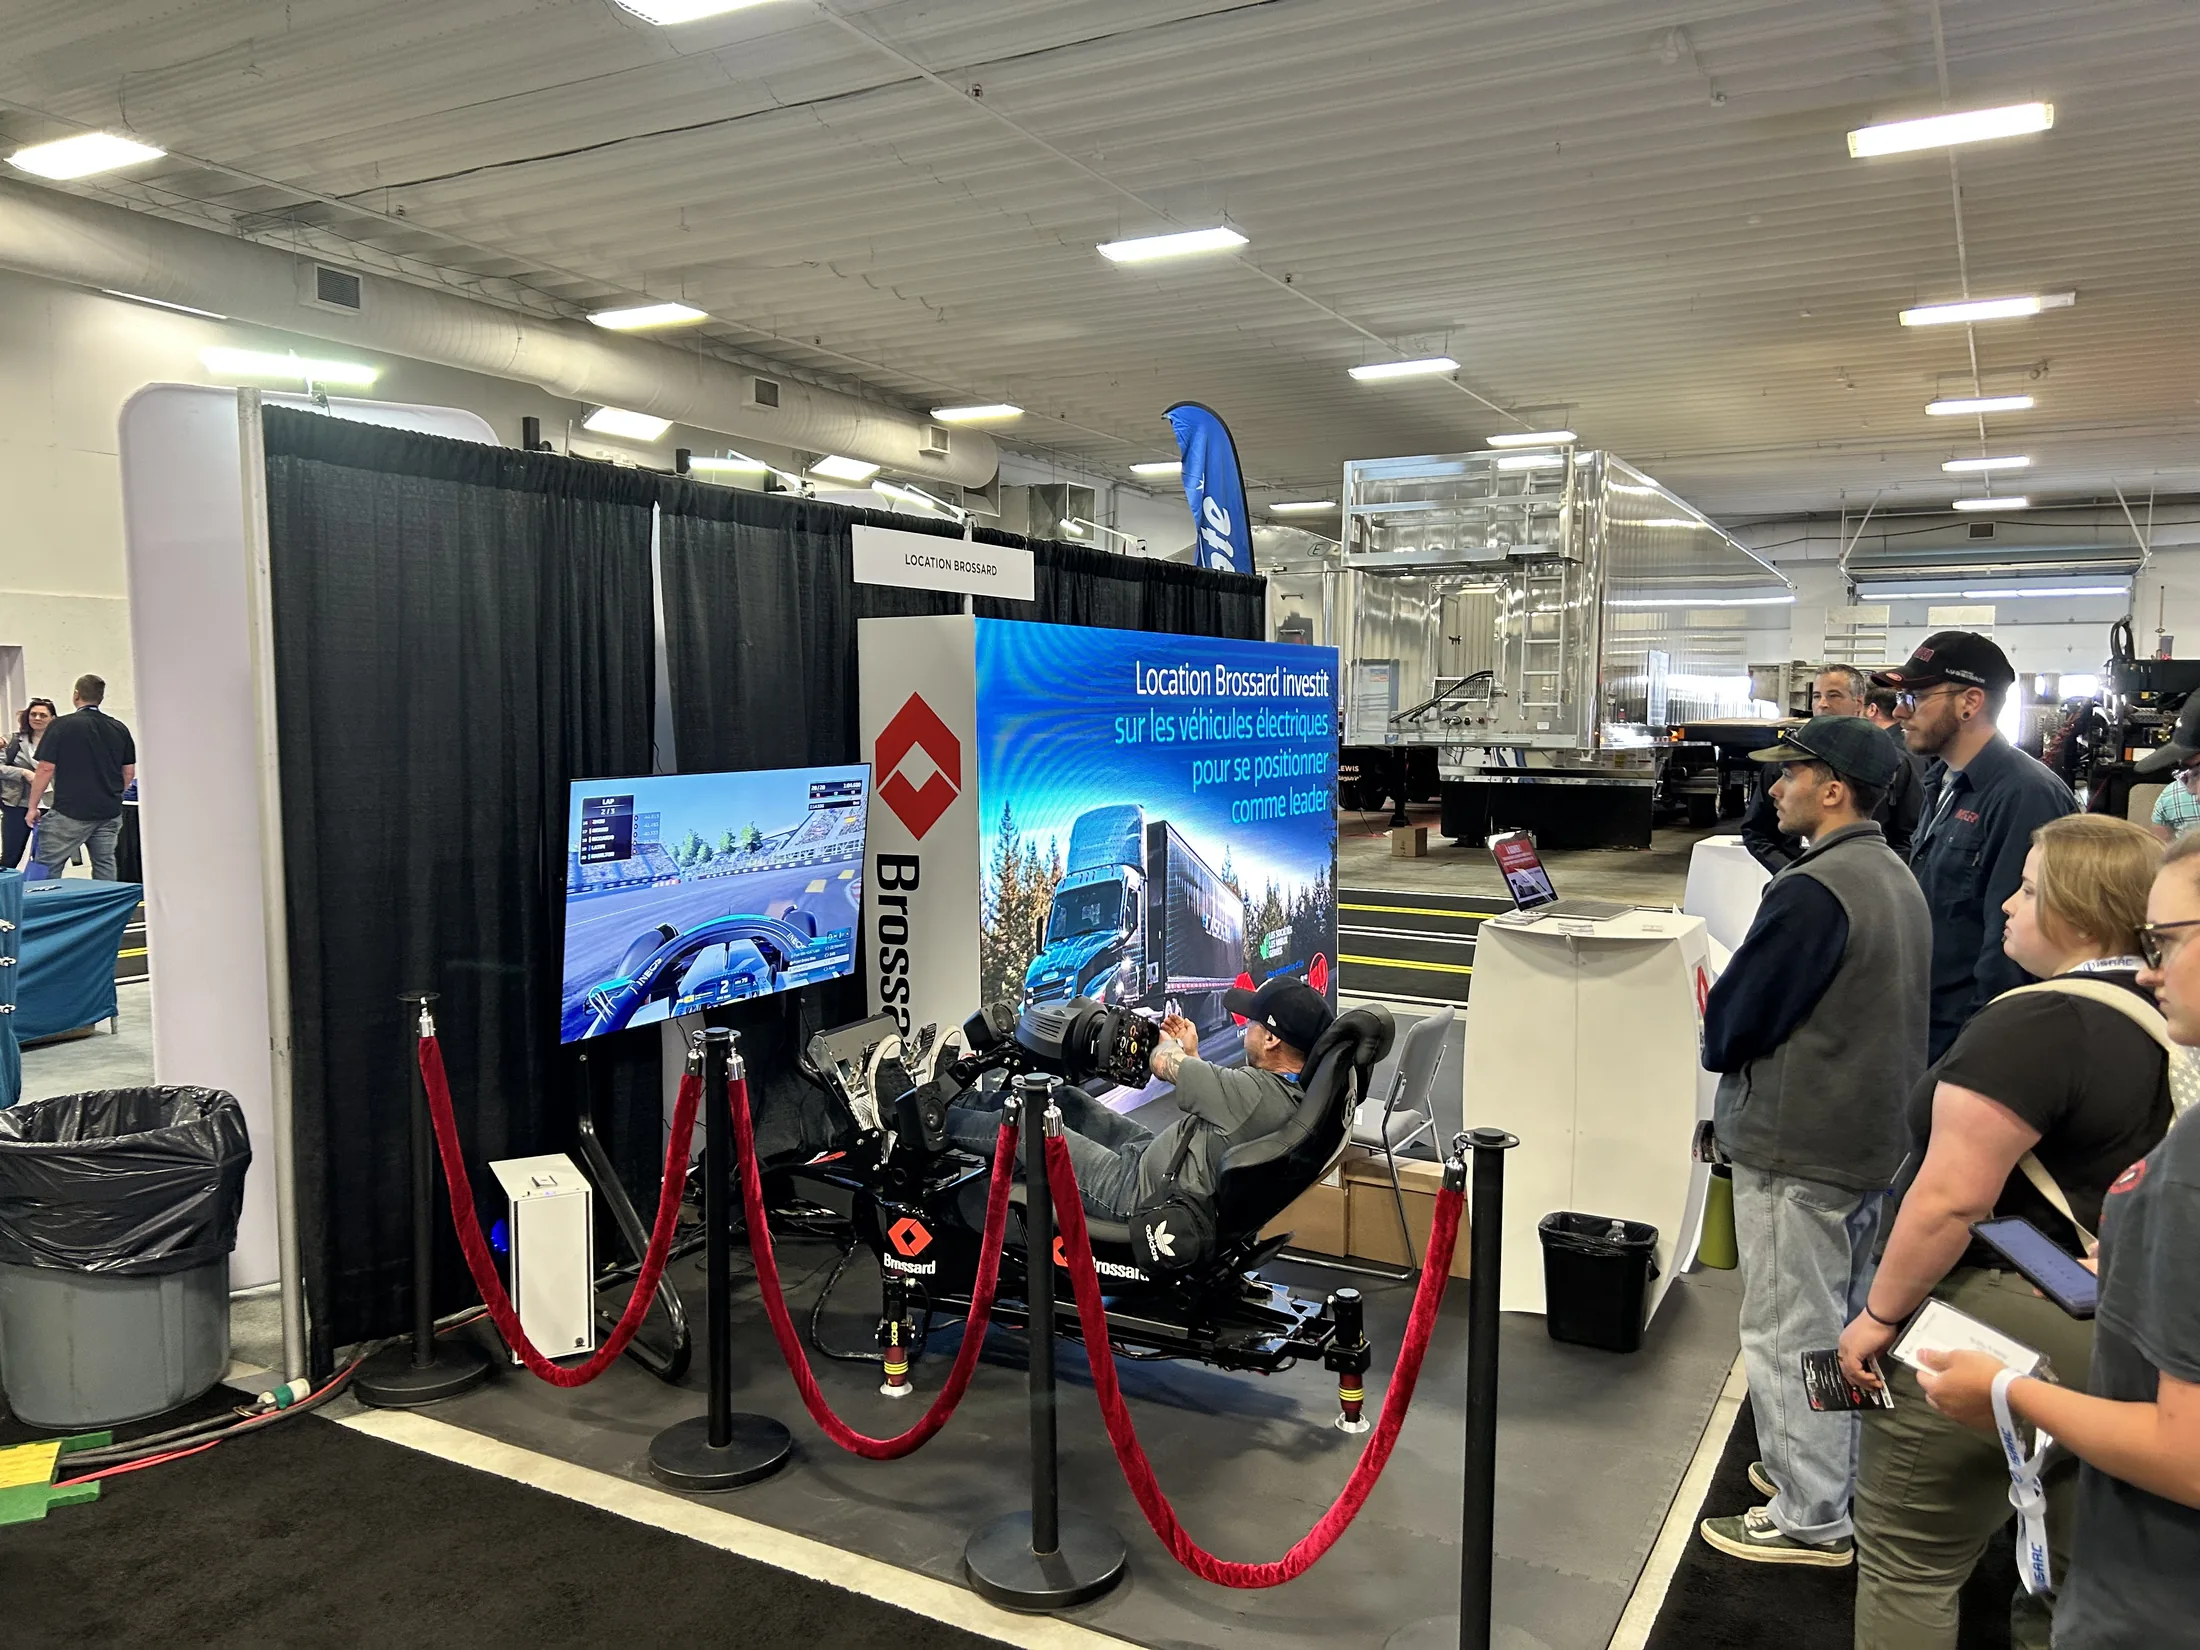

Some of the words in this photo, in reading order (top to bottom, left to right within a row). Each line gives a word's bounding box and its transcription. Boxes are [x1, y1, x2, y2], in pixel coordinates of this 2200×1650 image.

[905, 554, 951, 570] LOCATION
[954, 560, 998, 576] BROSSARD
[1136, 660, 1211, 696] Location
[1215, 664, 1279, 697] Brossard
[1283, 667, 1329, 697] investit
[1115, 716, 1146, 744] sur
[1151, 707, 1175, 743] les
[1179, 707, 1252, 741] véhicules
[1256, 707, 1328, 743] électriques
[1193, 758, 1230, 793] pour
[1233, 757, 1250, 782] se
[1254, 748, 1328, 787] positionner
[1232, 794, 1286, 824] comme
[1289, 784, 1328, 816] leader
[636, 958, 662, 986] INEOS
[720, 980, 729, 994] 2
[1146, 1224, 1160, 1262] adidas
